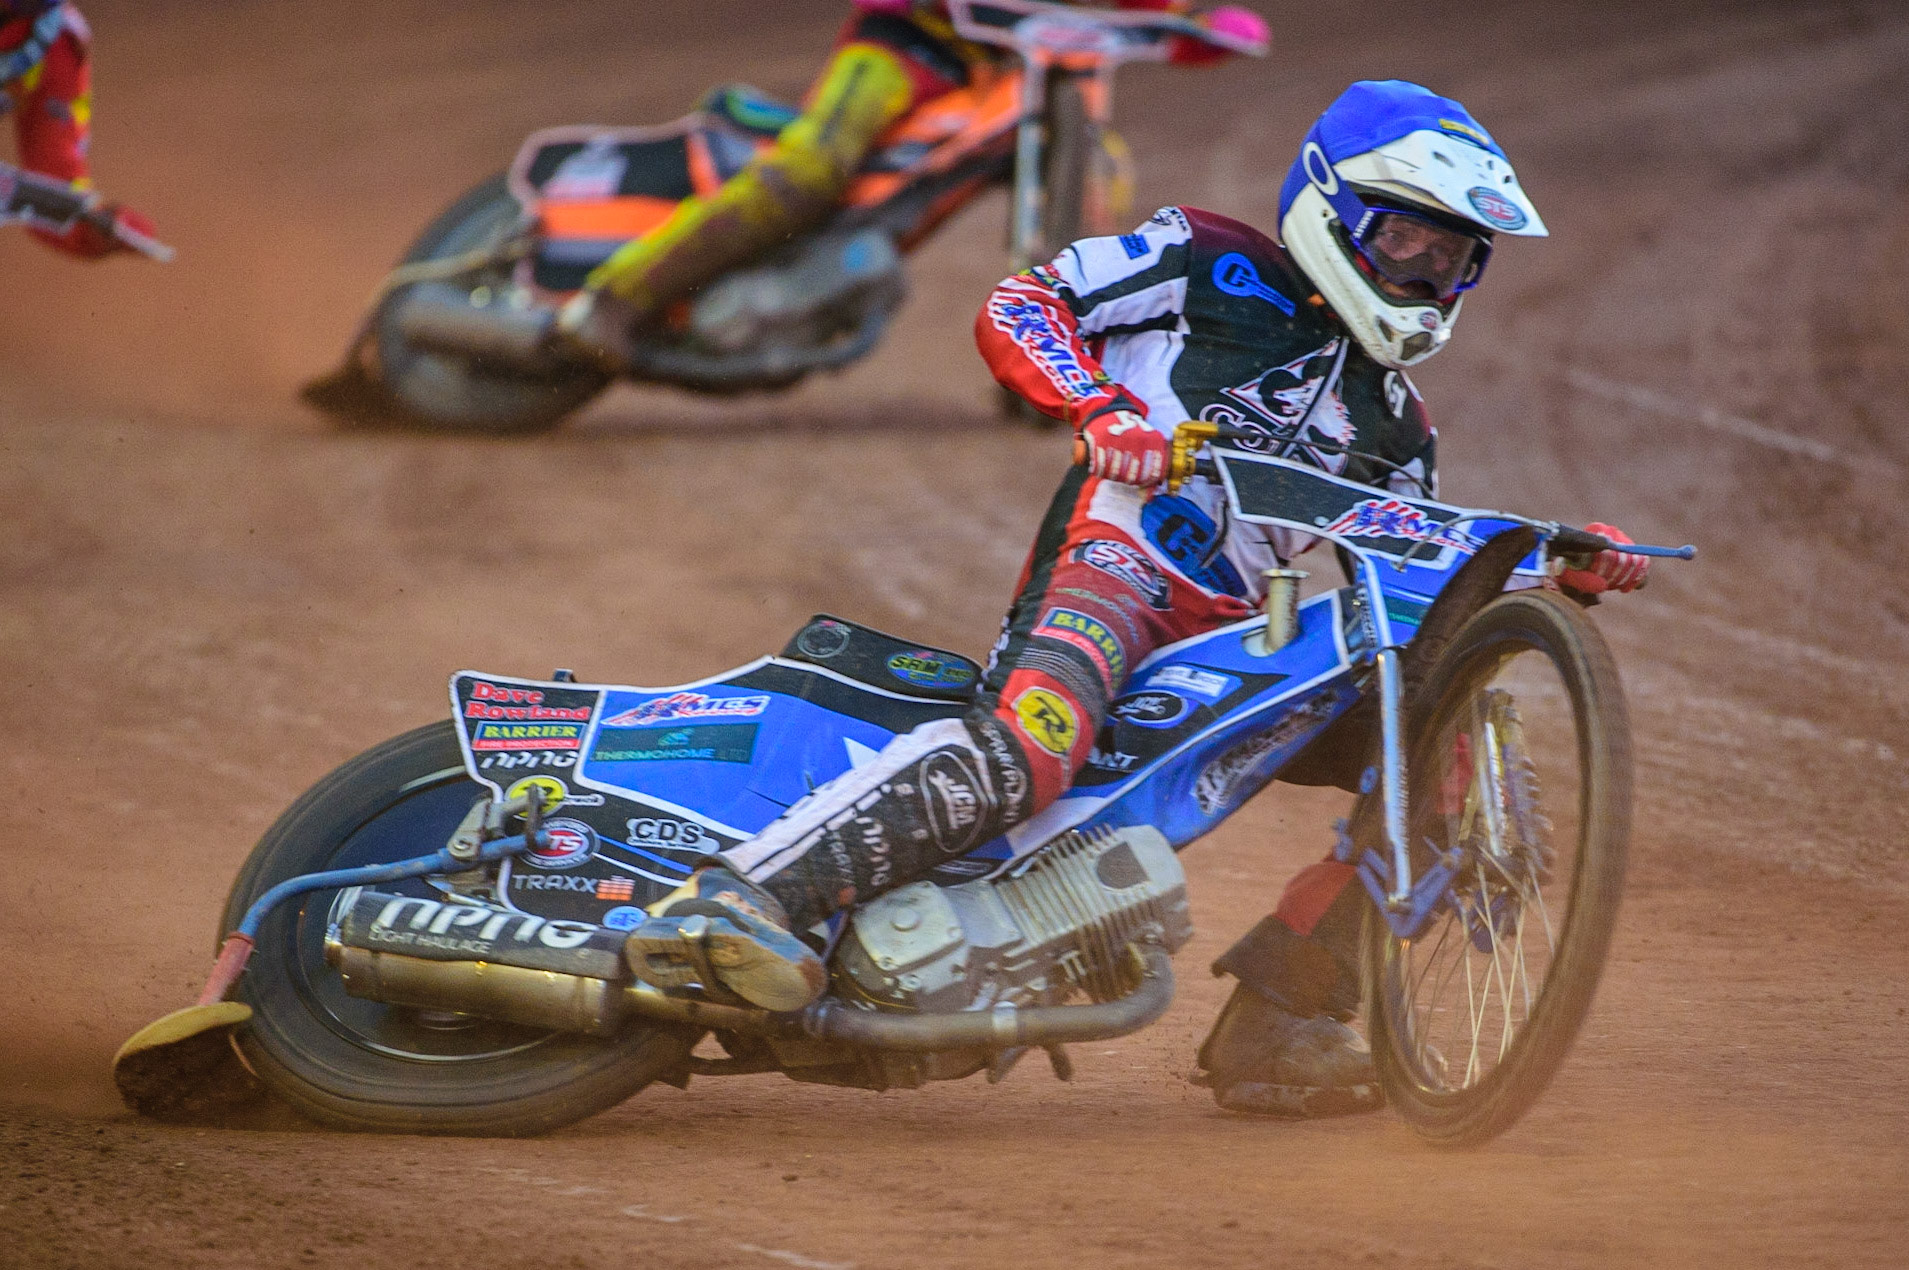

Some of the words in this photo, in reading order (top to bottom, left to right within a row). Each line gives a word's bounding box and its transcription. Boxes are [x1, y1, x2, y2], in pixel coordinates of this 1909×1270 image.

[471, 682, 545, 704] Dave
[464, 700, 592, 720] Rowland
[484, 725, 578, 738] BARRIER
[635, 820, 702, 844] CDS
[547, 833, 584, 852] TS
[512, 874, 599, 895] TRAXX
